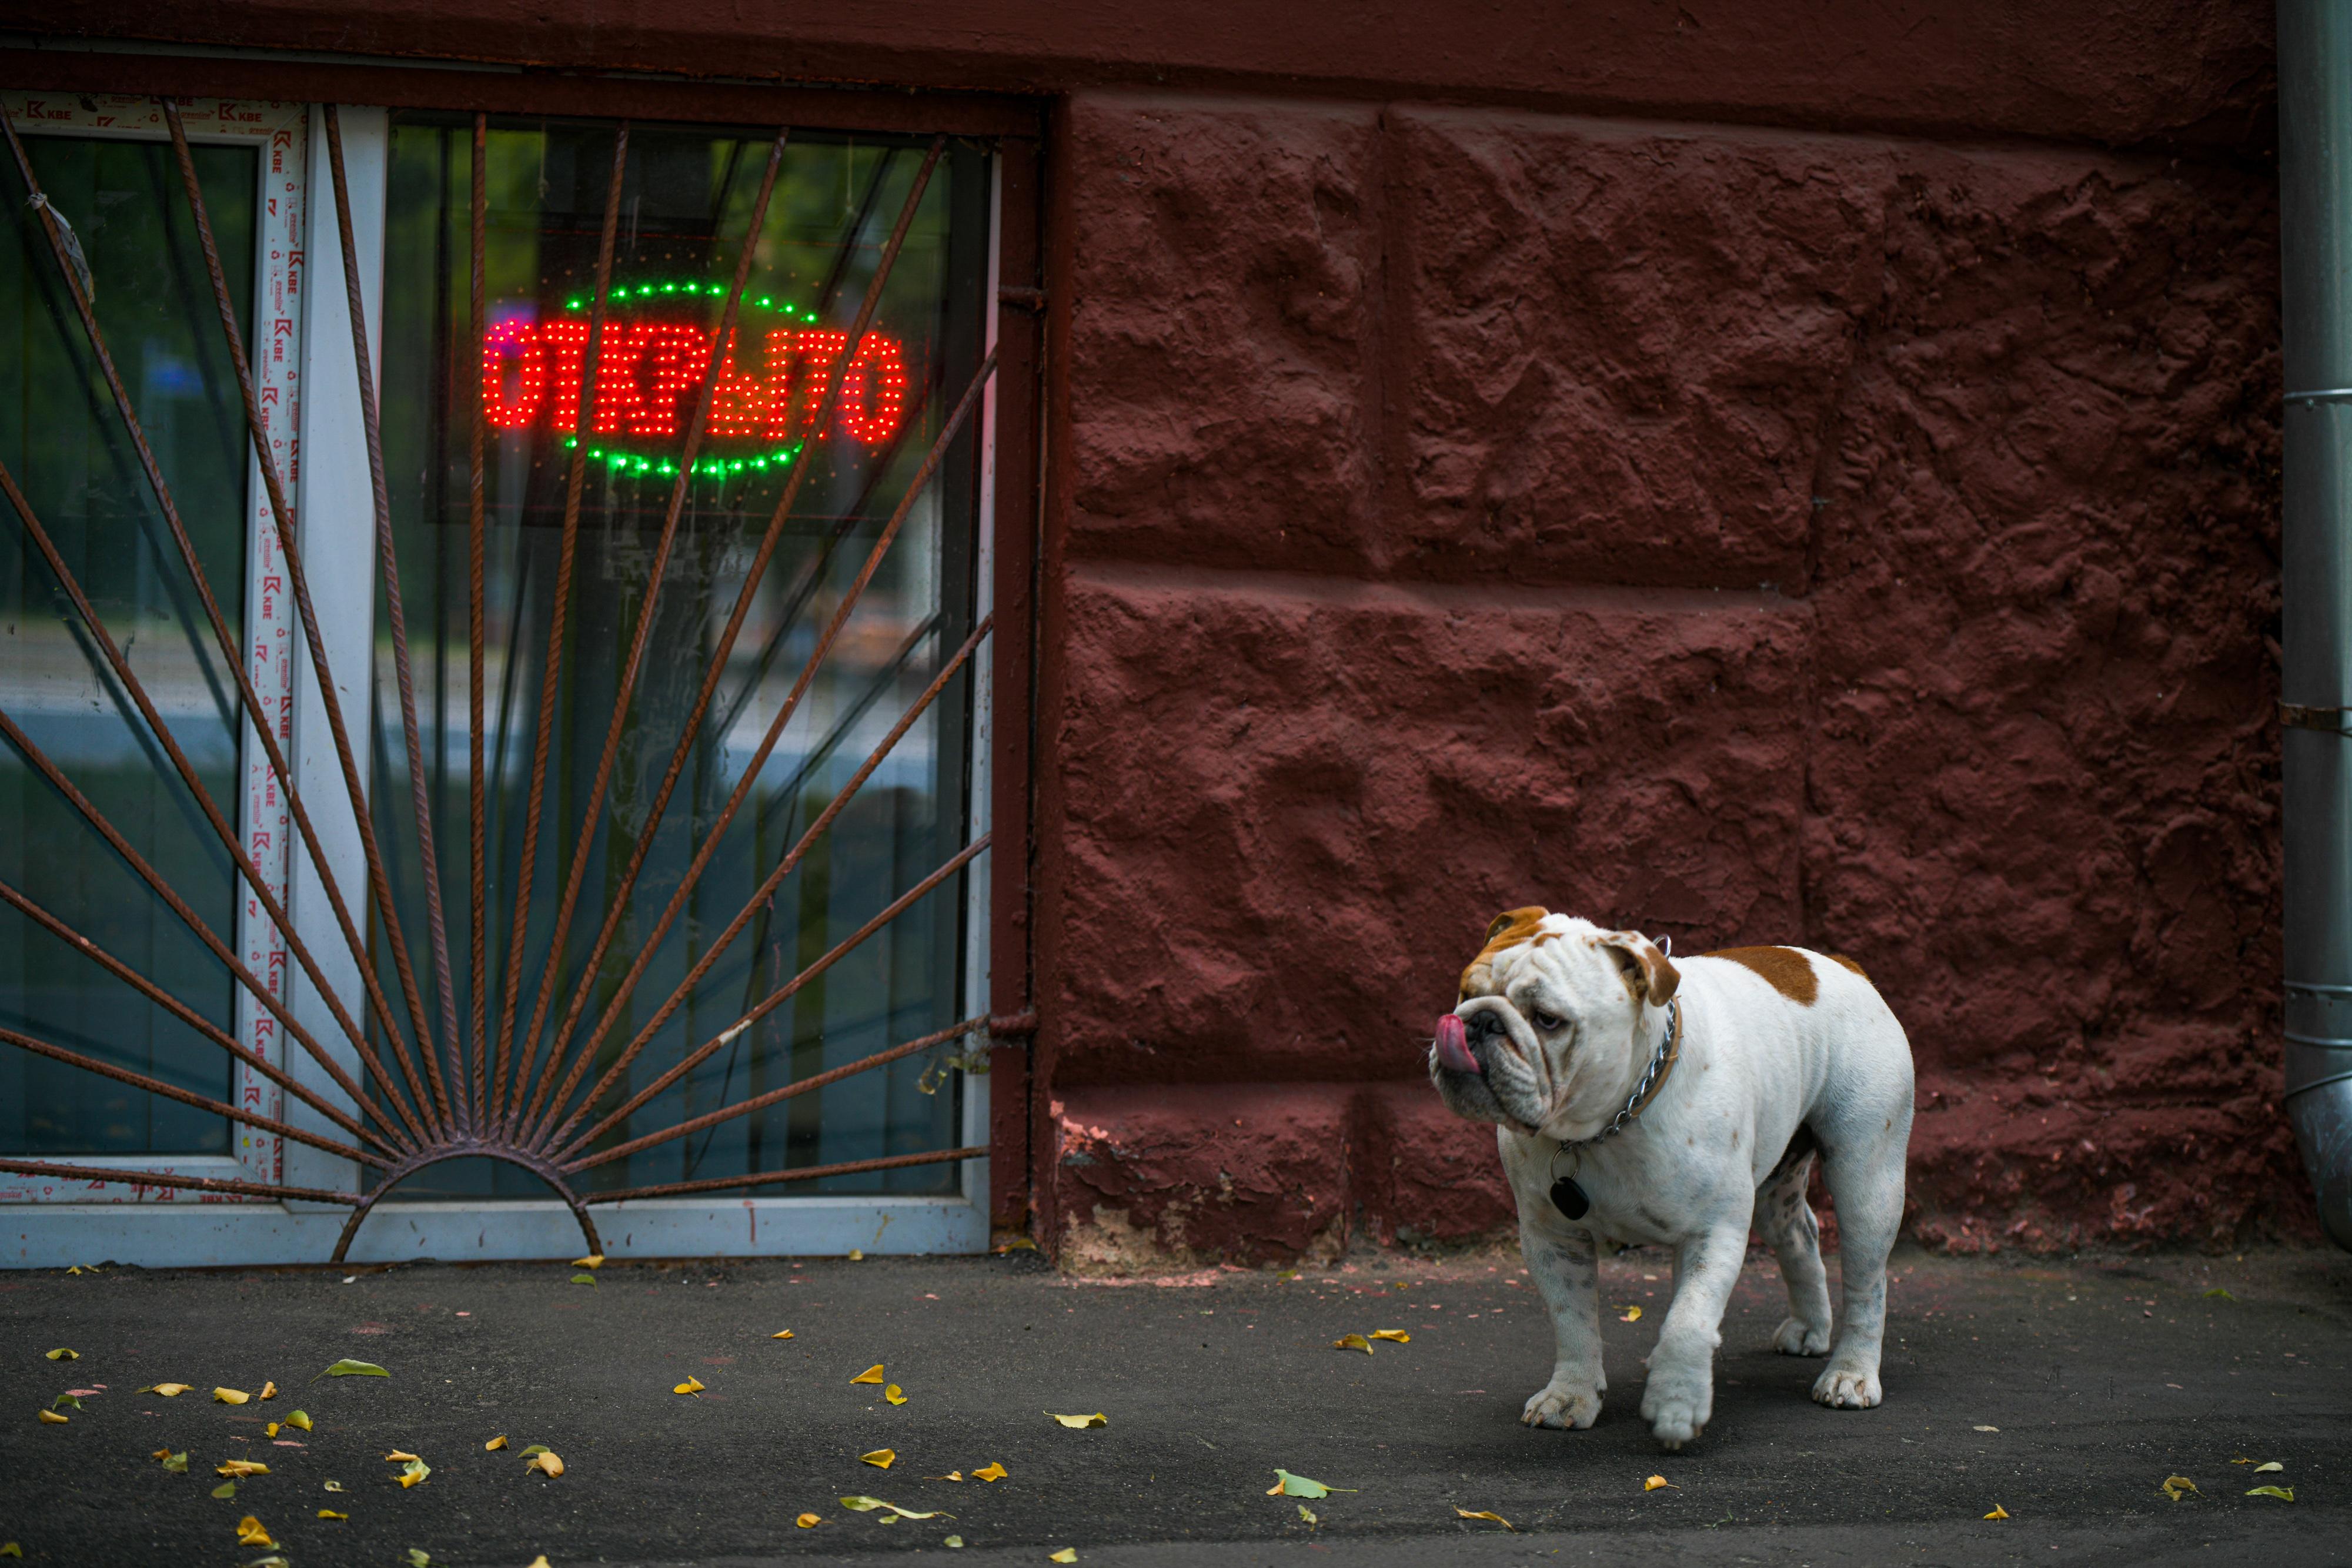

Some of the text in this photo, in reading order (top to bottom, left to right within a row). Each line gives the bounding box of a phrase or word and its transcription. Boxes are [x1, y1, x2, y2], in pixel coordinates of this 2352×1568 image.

[48, 110, 72, 120] KBE
[239, 112, 262, 122] KBE
[272, 151, 282, 173] KBE
[288, 271, 297, 295] KBE
[273, 339, 283, 362] KBE
[482, 319, 904, 442] ОТКРЫТО
[263, 596, 272, 620] KBE
[280, 716, 289, 740] KBE
[266, 784, 275, 807] KBE
[268, 971, 278, 995] KBE
[273, 1157, 281, 1181] KBE
[199, 1194, 222, 1203] KBE
